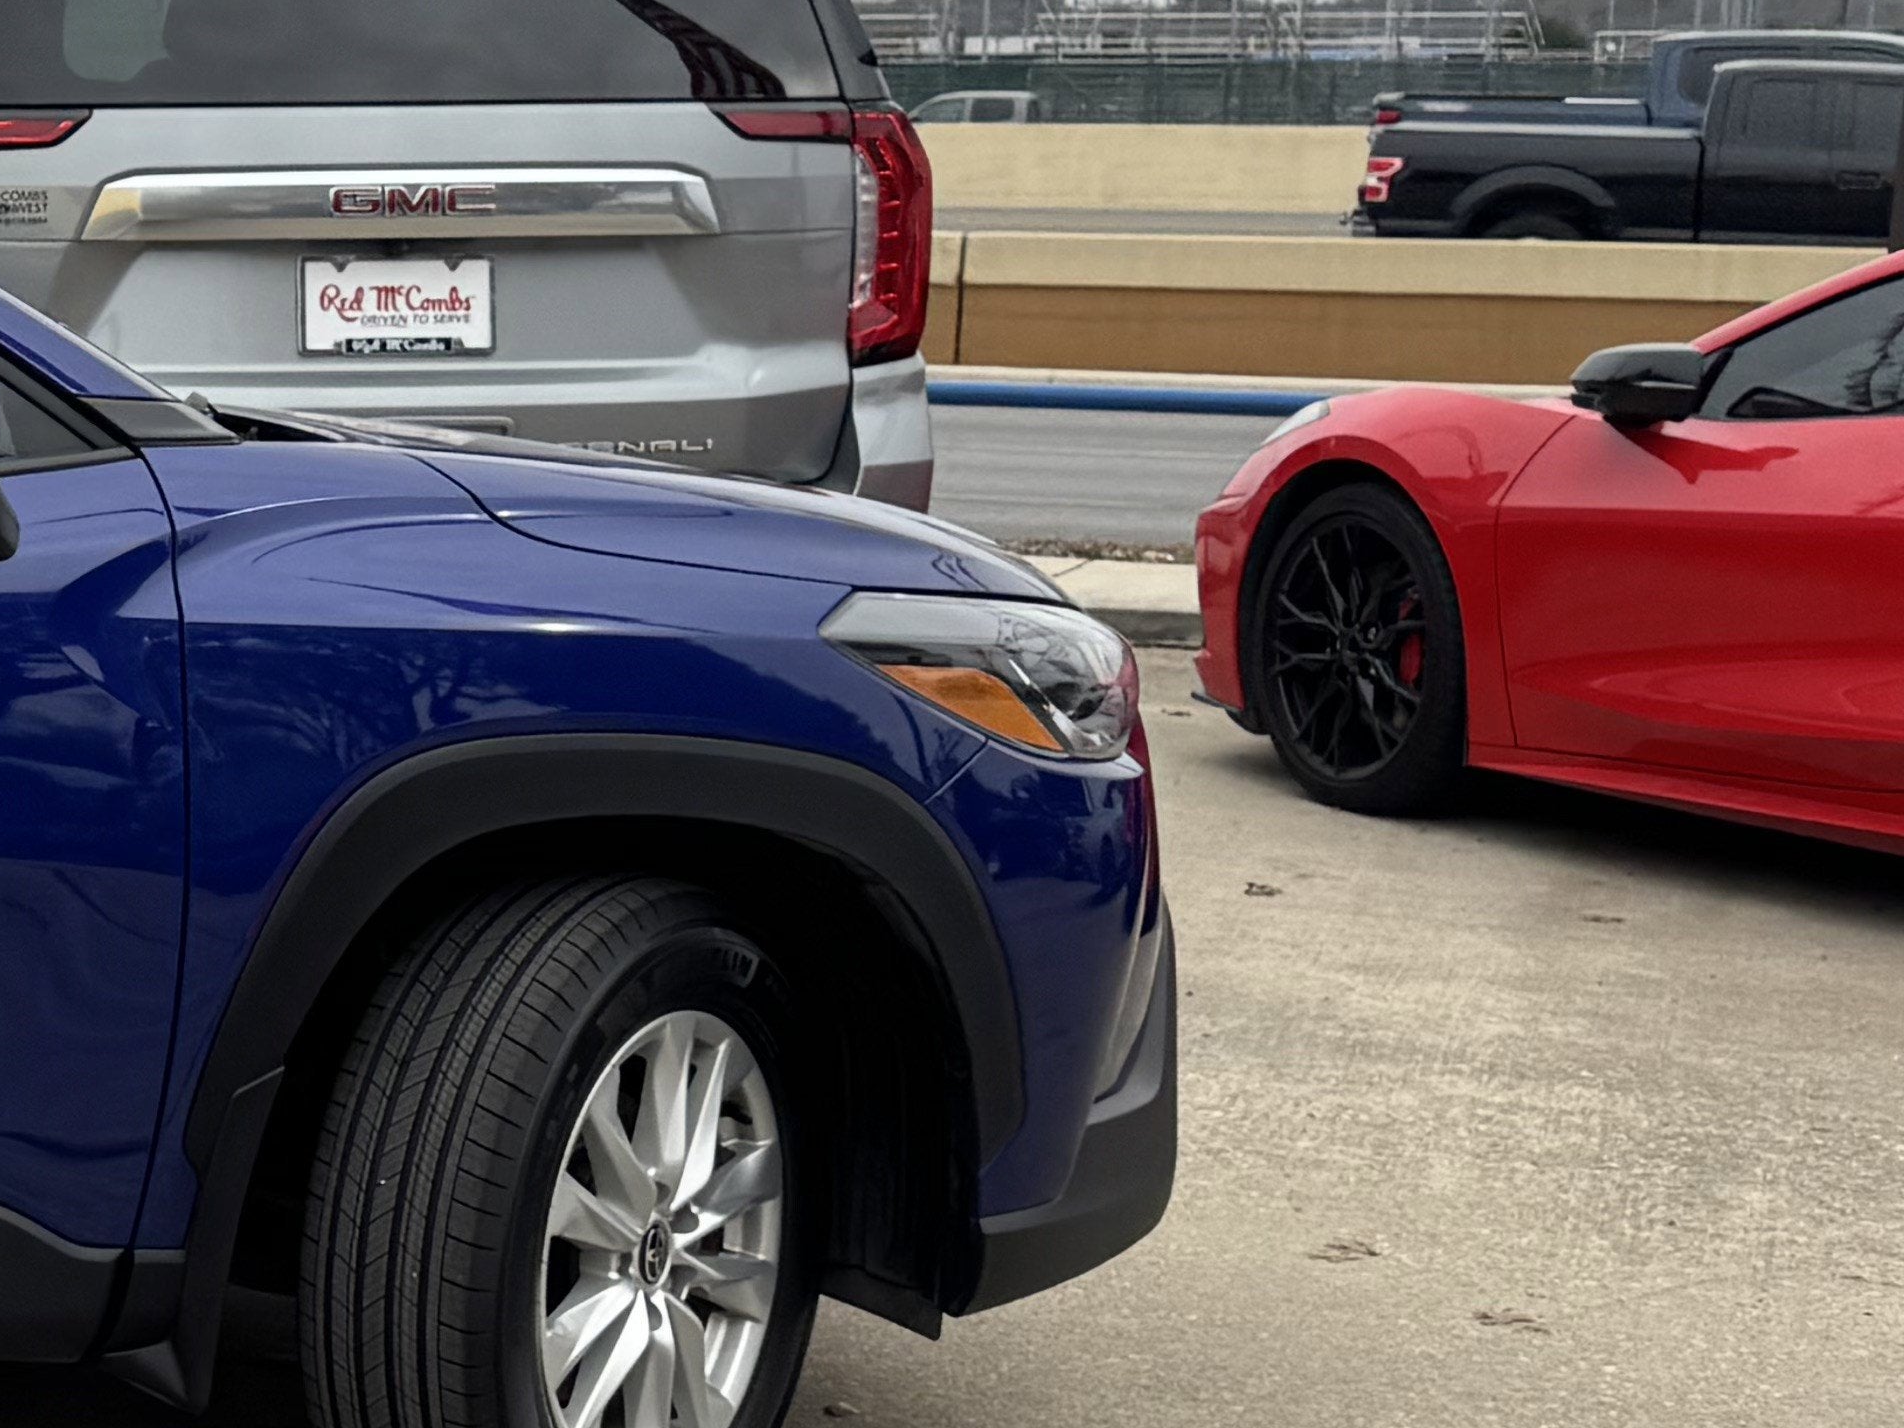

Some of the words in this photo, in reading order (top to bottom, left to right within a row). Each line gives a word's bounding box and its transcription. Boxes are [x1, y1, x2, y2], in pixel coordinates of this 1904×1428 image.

[329, 184, 496, 217] GMC
[319, 283, 365, 322] Red
[369, 284, 472, 312] McCombs
[413, 313, 429, 324] TO
[433, 313, 471, 324] SERVE
